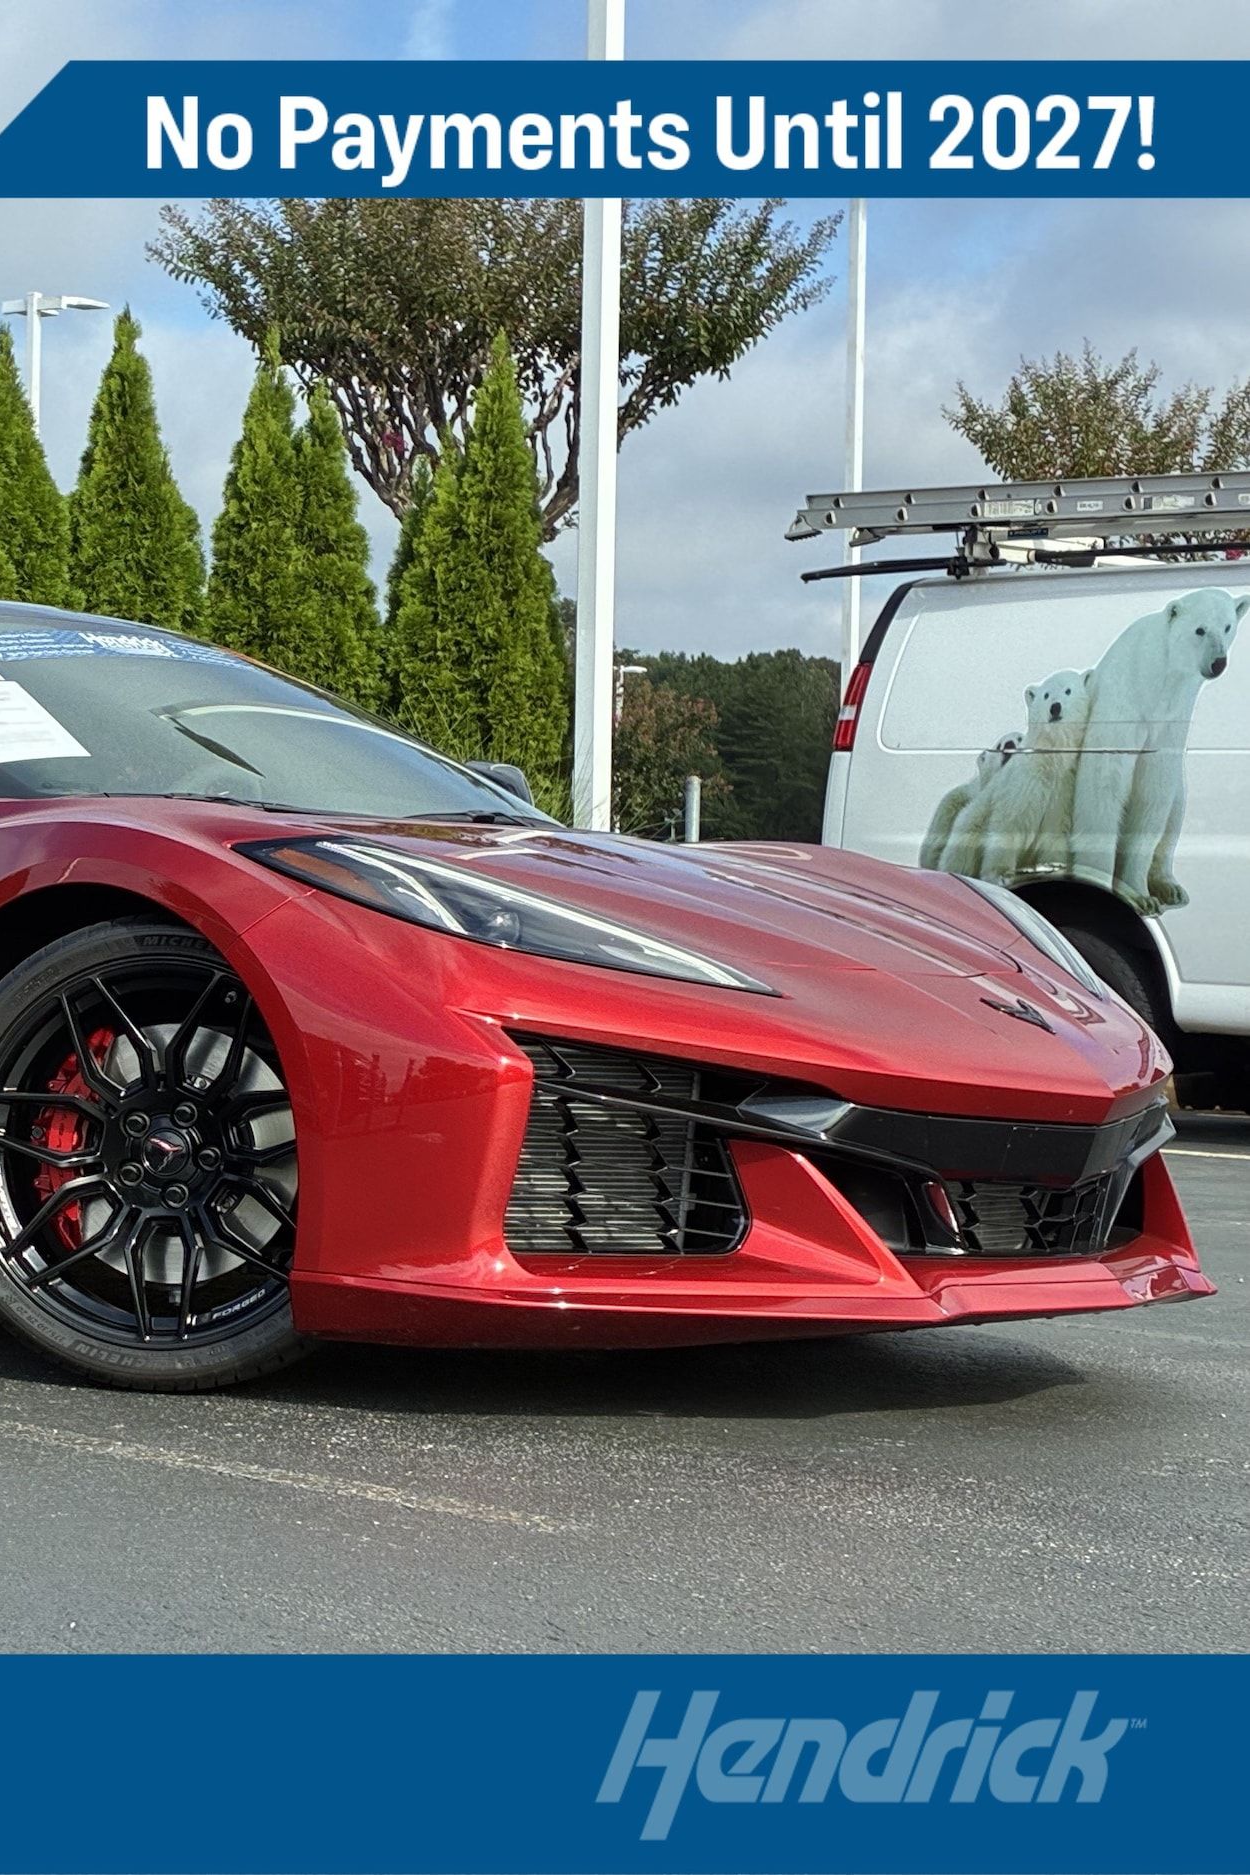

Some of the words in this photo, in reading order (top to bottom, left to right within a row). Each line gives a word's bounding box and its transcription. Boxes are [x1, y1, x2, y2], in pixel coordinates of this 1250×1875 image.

[142, 935, 208, 950] MICHE
[212, 1288, 266, 1320] FORGED
[75, 1342, 150, 1370] CHELIN
